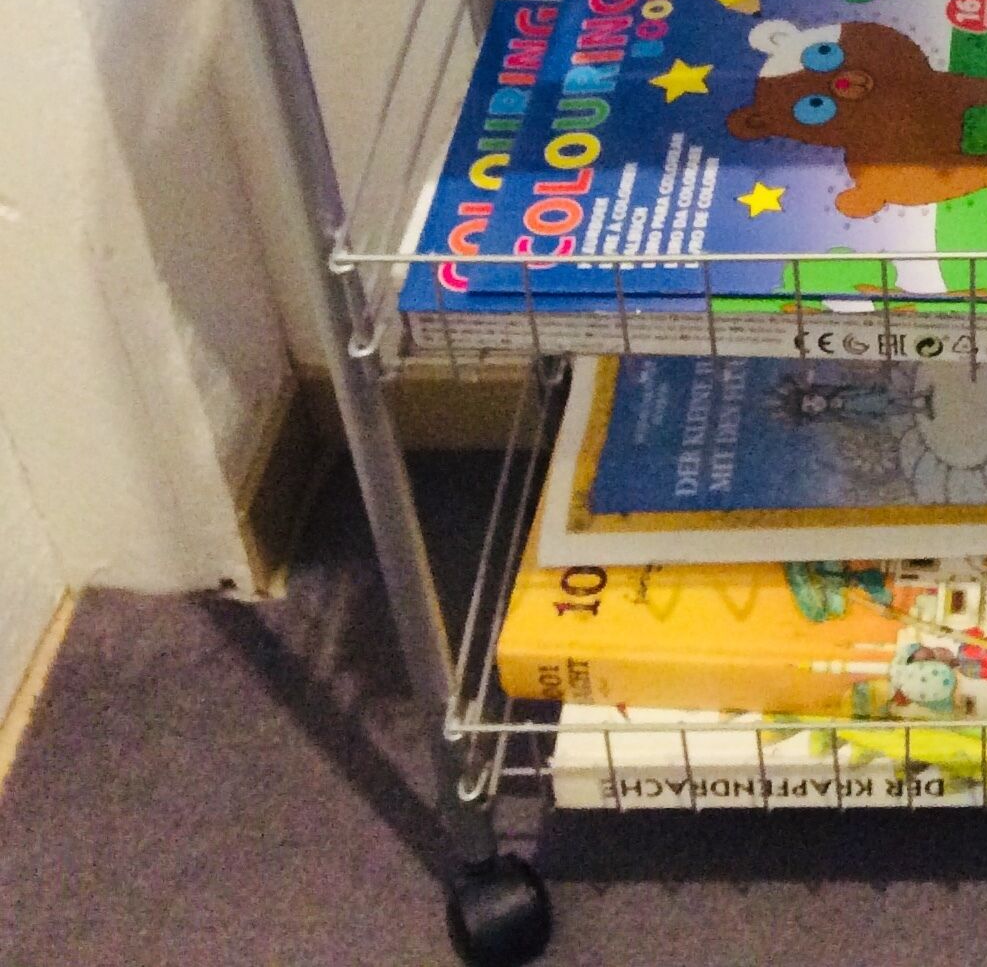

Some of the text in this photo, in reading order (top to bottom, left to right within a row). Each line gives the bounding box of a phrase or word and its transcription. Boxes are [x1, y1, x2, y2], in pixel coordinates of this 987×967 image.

[693, 210, 710, 228] DE
[602, 778, 946, 799] DER KRAPFENDRACHE
